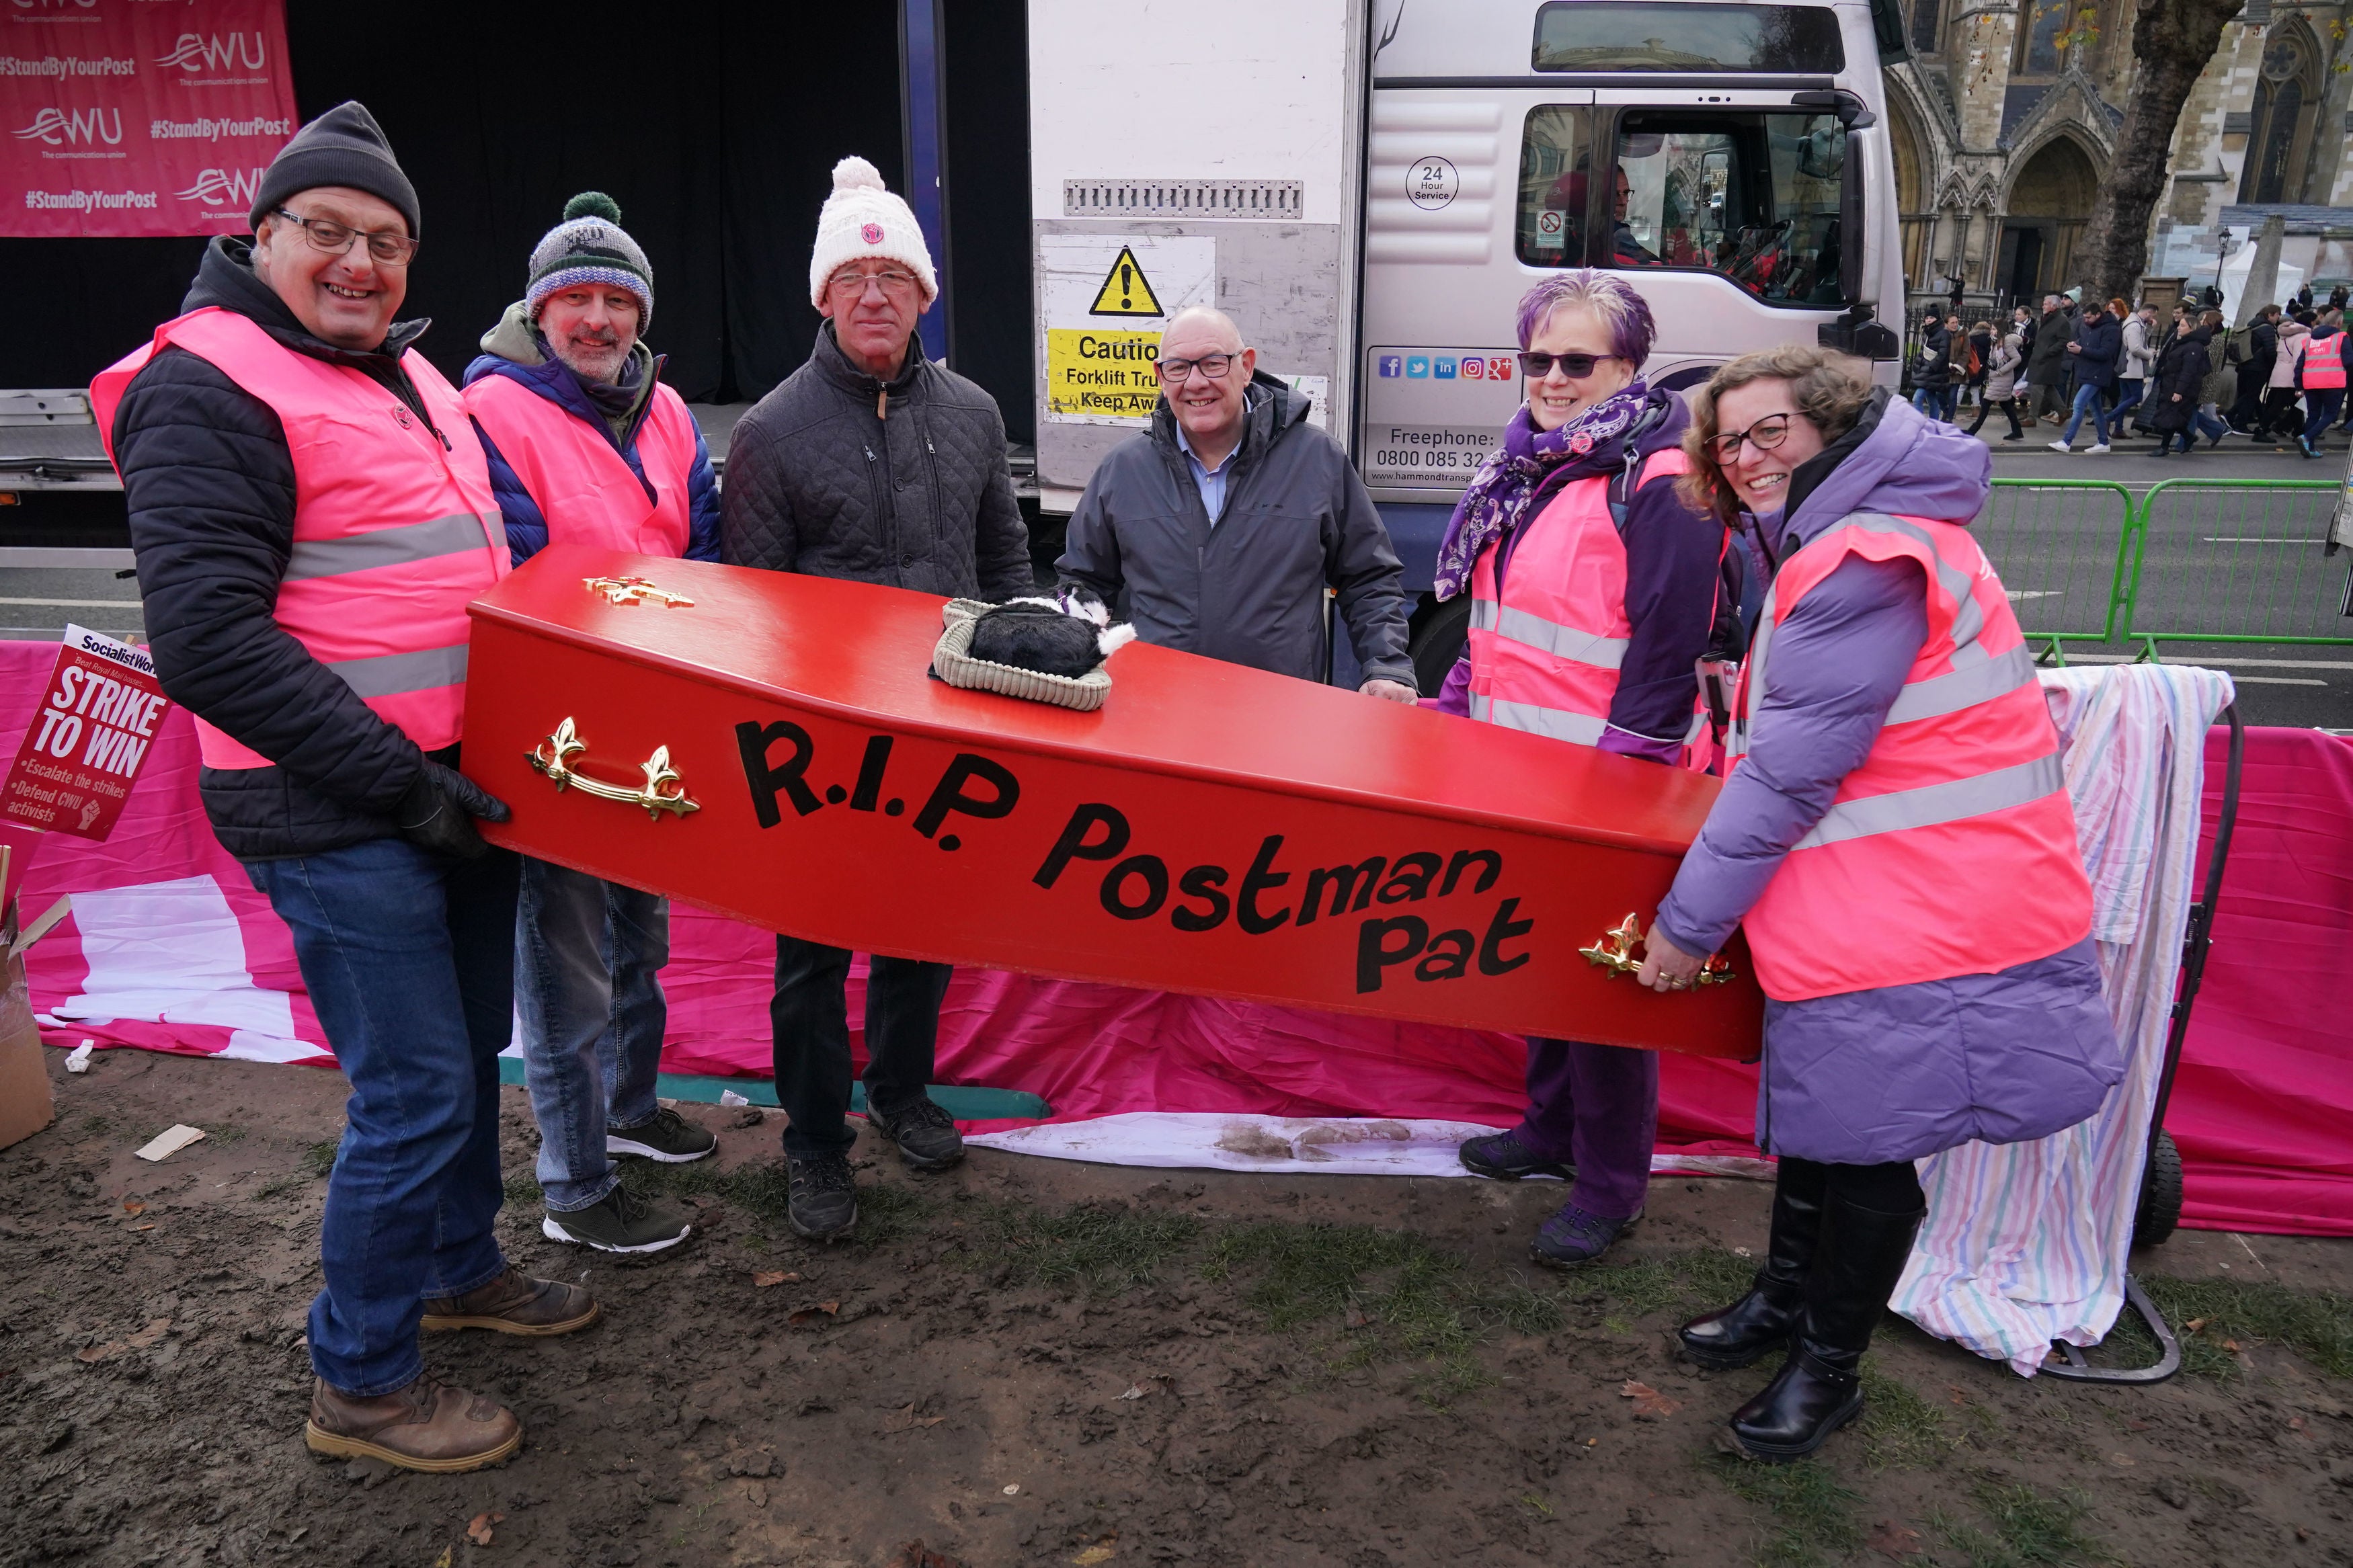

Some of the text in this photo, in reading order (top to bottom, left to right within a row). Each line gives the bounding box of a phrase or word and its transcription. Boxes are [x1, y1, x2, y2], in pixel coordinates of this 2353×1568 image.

[171, 32, 265, 72] CWU
[31, 107, 122, 146] CWU
[151, 117, 290, 142] #StandByYourPost
[1421, 181, 1444, 190] Hour
[1423, 166, 1443, 181] 24
[193, 167, 265, 206] CW
[1414, 191, 1449, 200] Service
[26, 190, 157, 214] #StandByYourPost
[201, 211, 249, 219] The communic
[1079, 335, 1160, 362] Cautio
[1066, 368, 1158, 387] Forklift Tru
[1080, 392, 1156, 413] Keep Aw
[1390, 428, 1494, 448] Freephone:
[1378, 450, 1484, 468] 0800 085 32
[75, 656, 93, 669] Beat
[92, 662, 111, 675] Royal
[110, 669, 126, 680] Mail
[52, 665, 167, 738] STRIKE
[34, 707, 149, 779] TO WIN
[75, 773, 91, 790] the
[92, 779, 126, 799] strikes
[7, 800, 56, 823] activists
[57, 792, 84, 811] CWU
[1032, 803, 1502, 935] Postman
